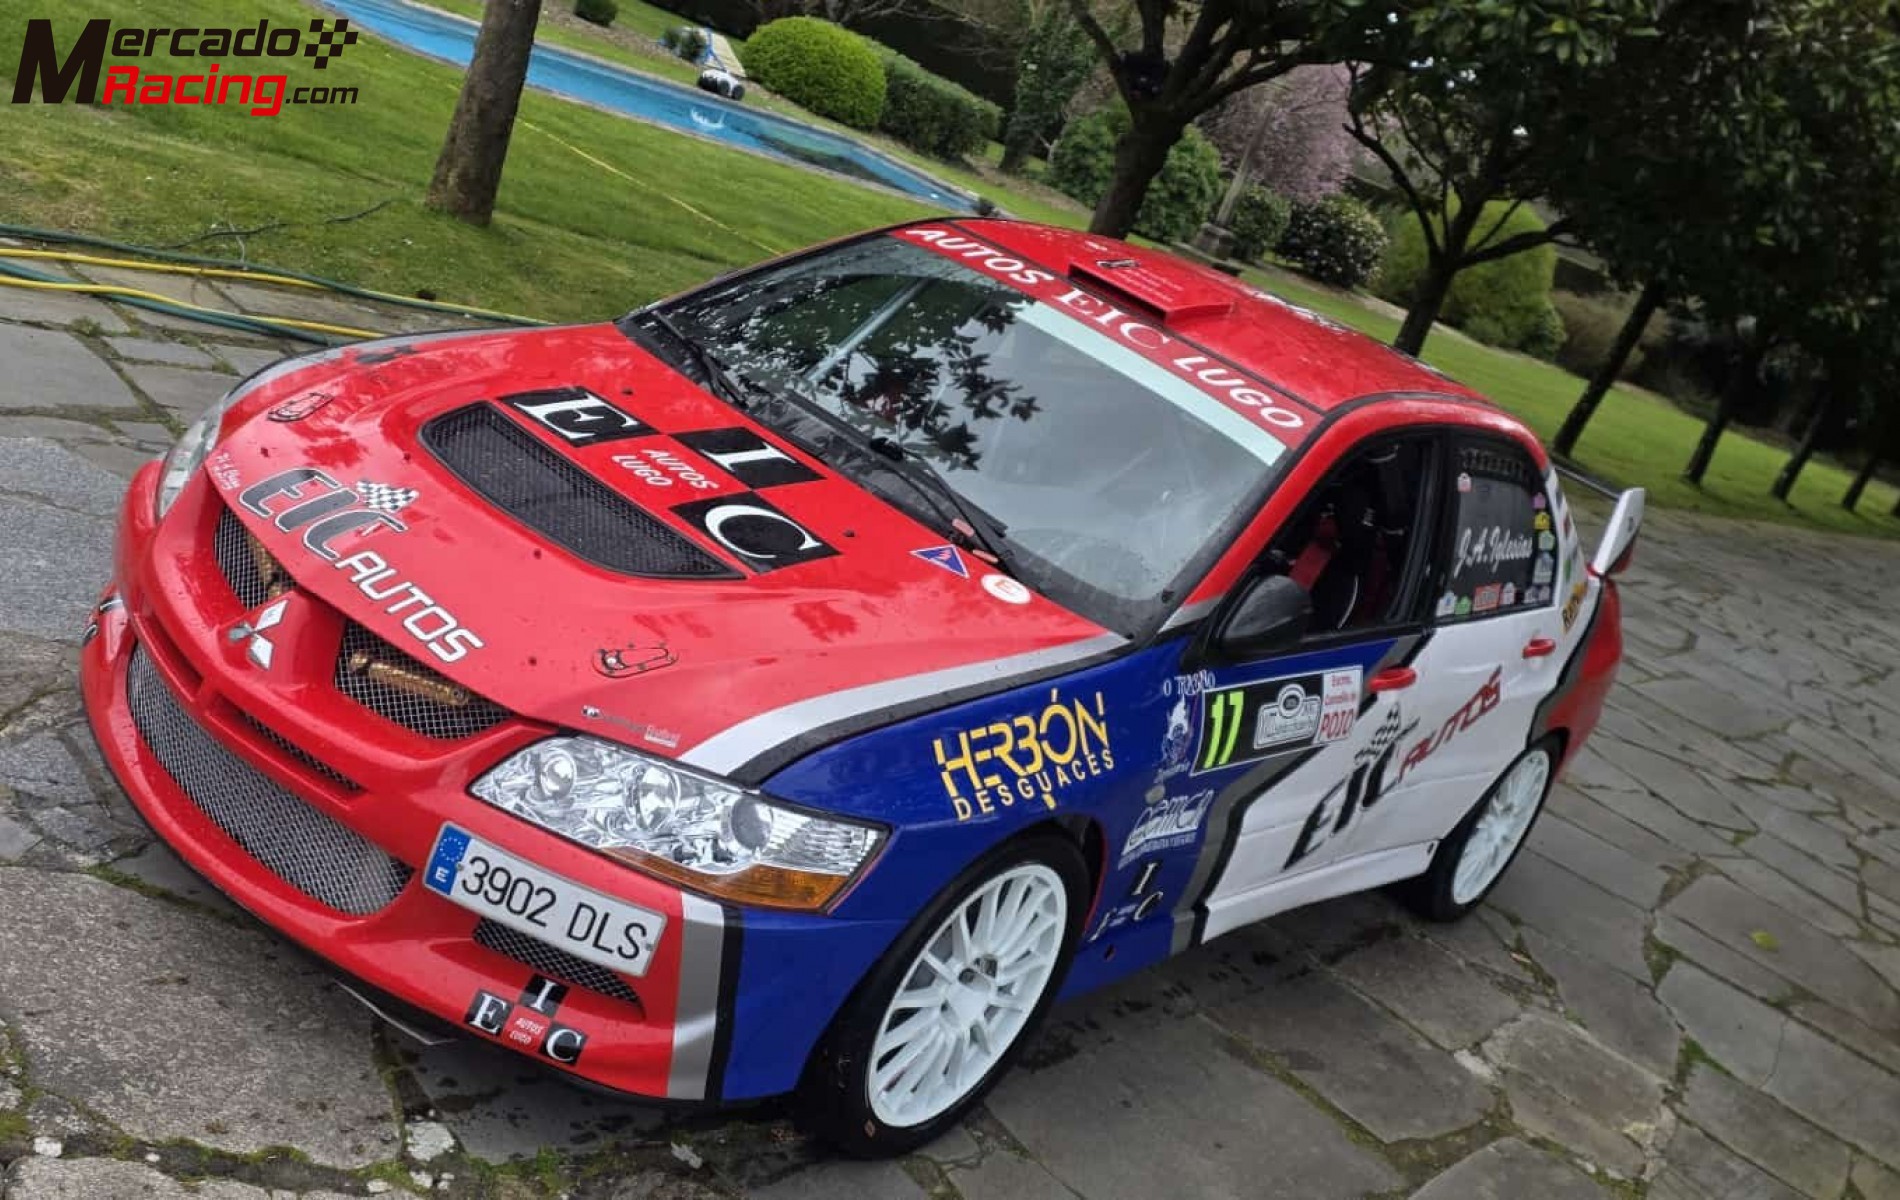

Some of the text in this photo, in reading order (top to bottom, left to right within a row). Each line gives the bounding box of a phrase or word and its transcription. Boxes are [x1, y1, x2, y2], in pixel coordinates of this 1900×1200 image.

[906, 228, 1055, 286] AUTOS
[1053, 287, 1170, 349] EIC
[1173, 356, 1305, 429] LUGO
[514, 393, 640, 439] E
[611, 454, 674, 488] LUGO
[642, 448, 719, 490] AUTOS
[239, 467, 408, 561] EIC
[705, 504, 824, 560] C
[335, 550, 485, 663] AUTOS
[933, 687, 1109, 798] HERBÓN
[1204, 690, 1245, 769] 17
[953, 749, 1115, 822] DESGUACES
[435, 866, 450, 883] E
[461, 855, 648, 960] 3902 DLS
[468, 995, 507, 1035] E
[546, 1028, 583, 1063] C
